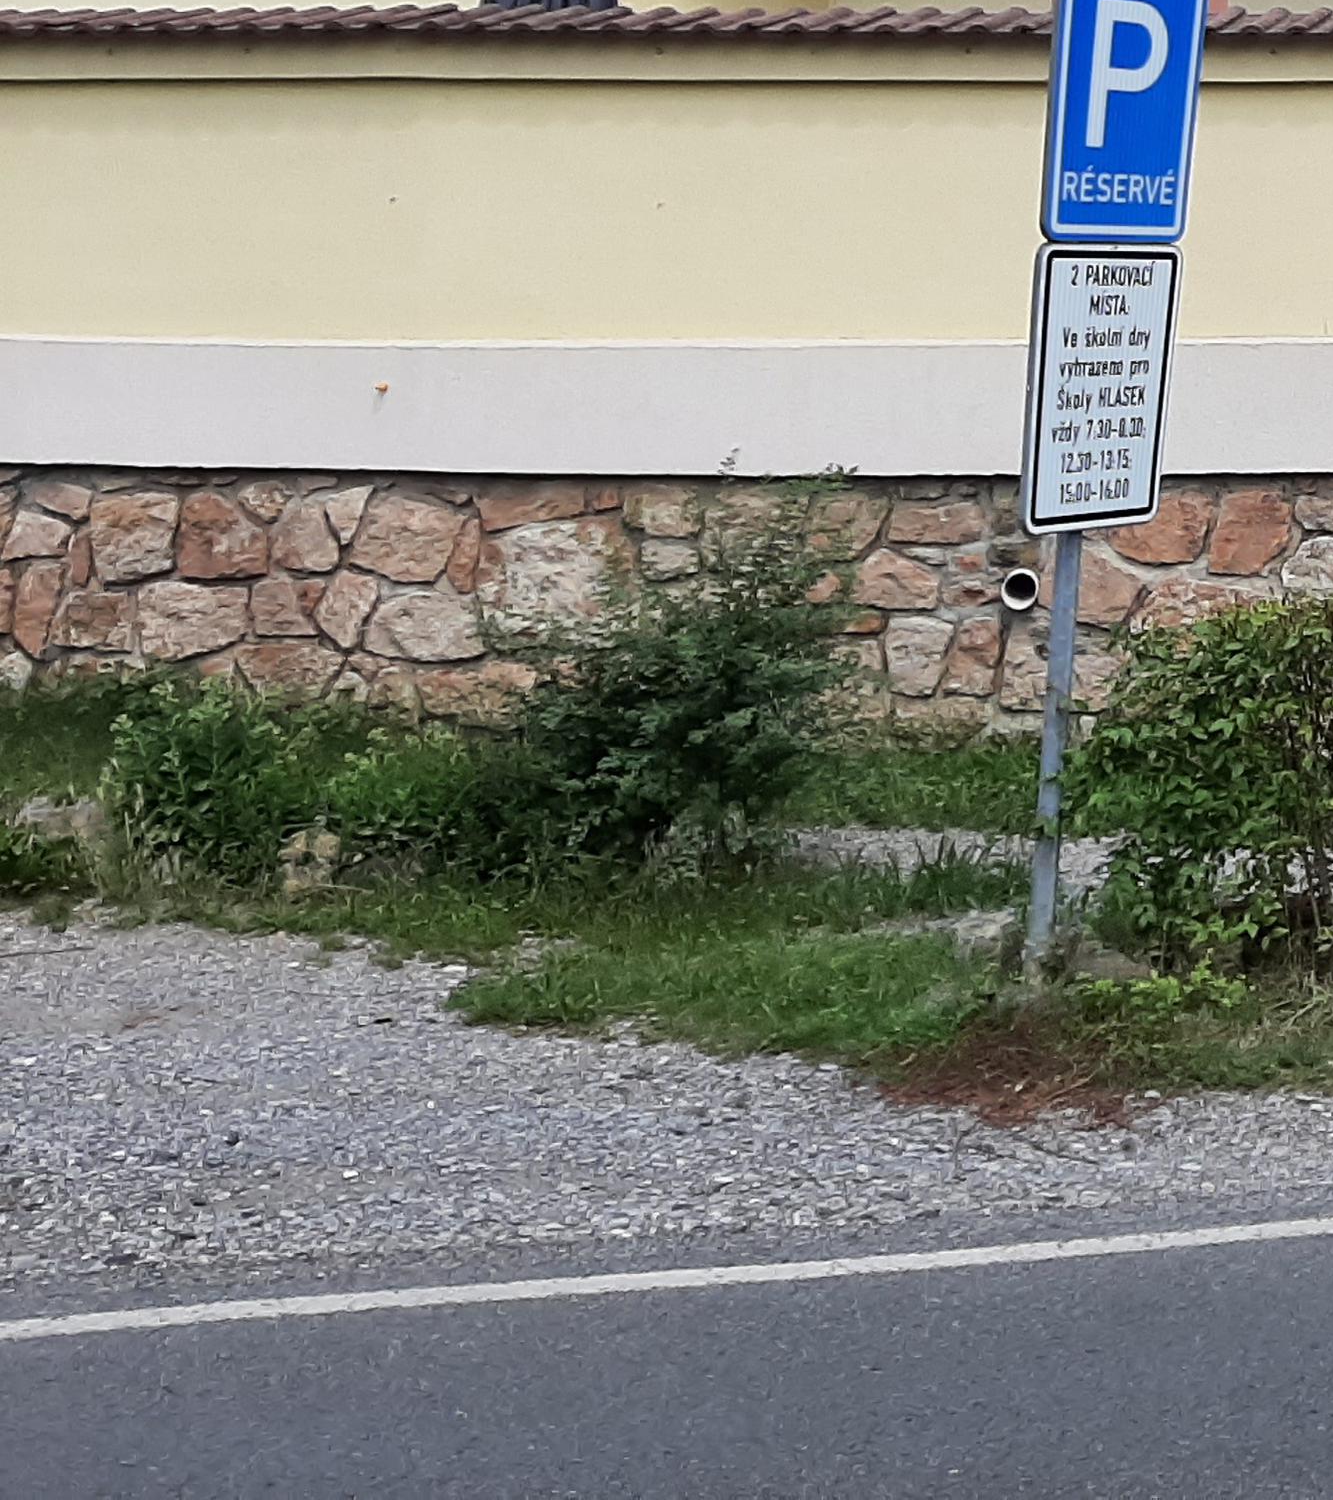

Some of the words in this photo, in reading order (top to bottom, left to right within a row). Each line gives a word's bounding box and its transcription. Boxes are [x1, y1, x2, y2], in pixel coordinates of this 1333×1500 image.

[1062, 165, 1175, 205] RÉSERVÉ
[1071, 264, 1079, 286] 2
[1086, 261, 1155, 287] PARKOVACÍ
[1063, 327, 1078, 348] Ve
[1129, 325, 1151, 350] dny
[1130, 359, 1149, 380] pro
[1057, 386, 1092, 414] Školy
[1098, 381, 1146, 407] HLÁSEK
[1052, 419, 1081, 445] vždy
